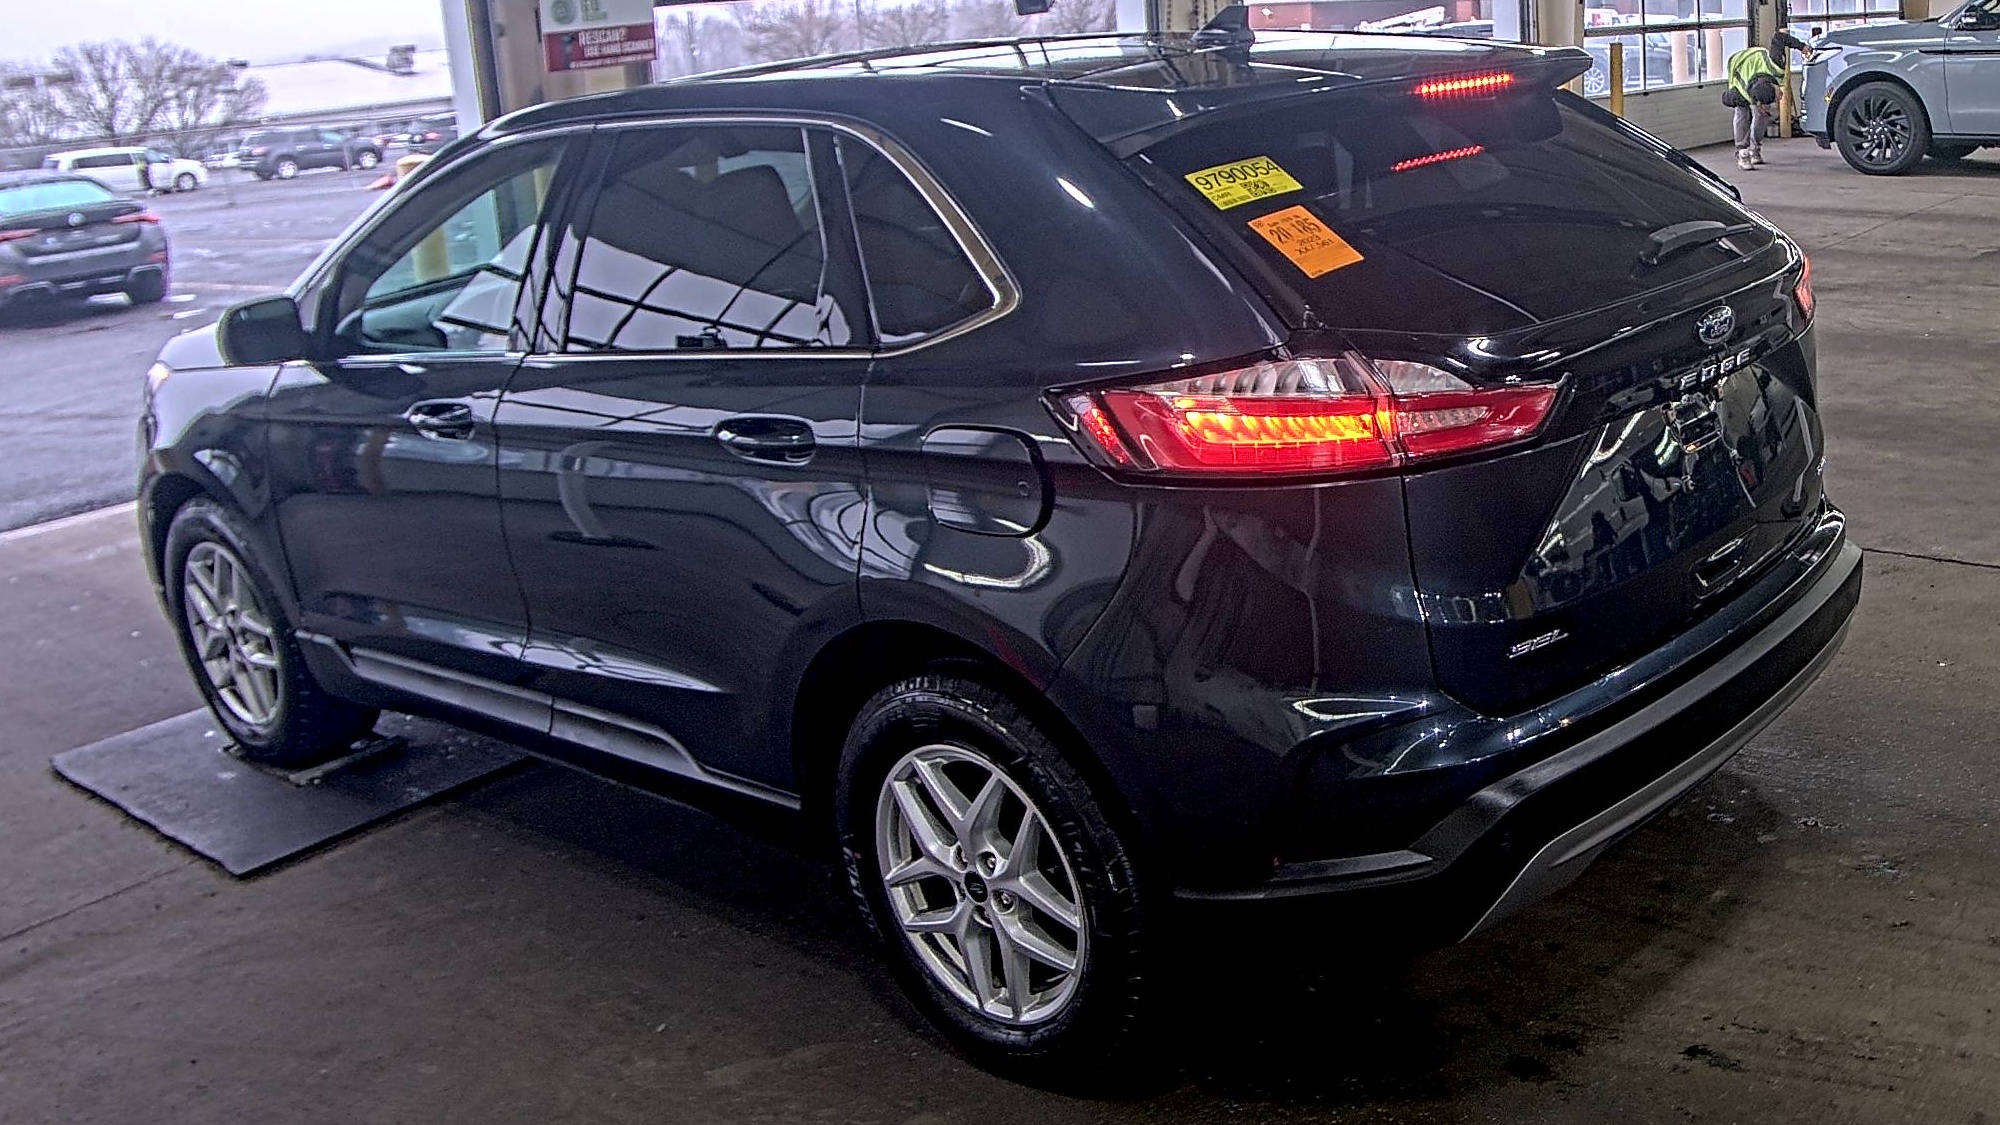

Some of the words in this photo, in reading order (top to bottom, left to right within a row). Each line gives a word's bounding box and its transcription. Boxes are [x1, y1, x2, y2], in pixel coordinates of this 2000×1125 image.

[1195, 161, 1280, 190] 9790054
[1290, 218, 1322, 236] 185
[1506, 629, 1569, 659] SEL
